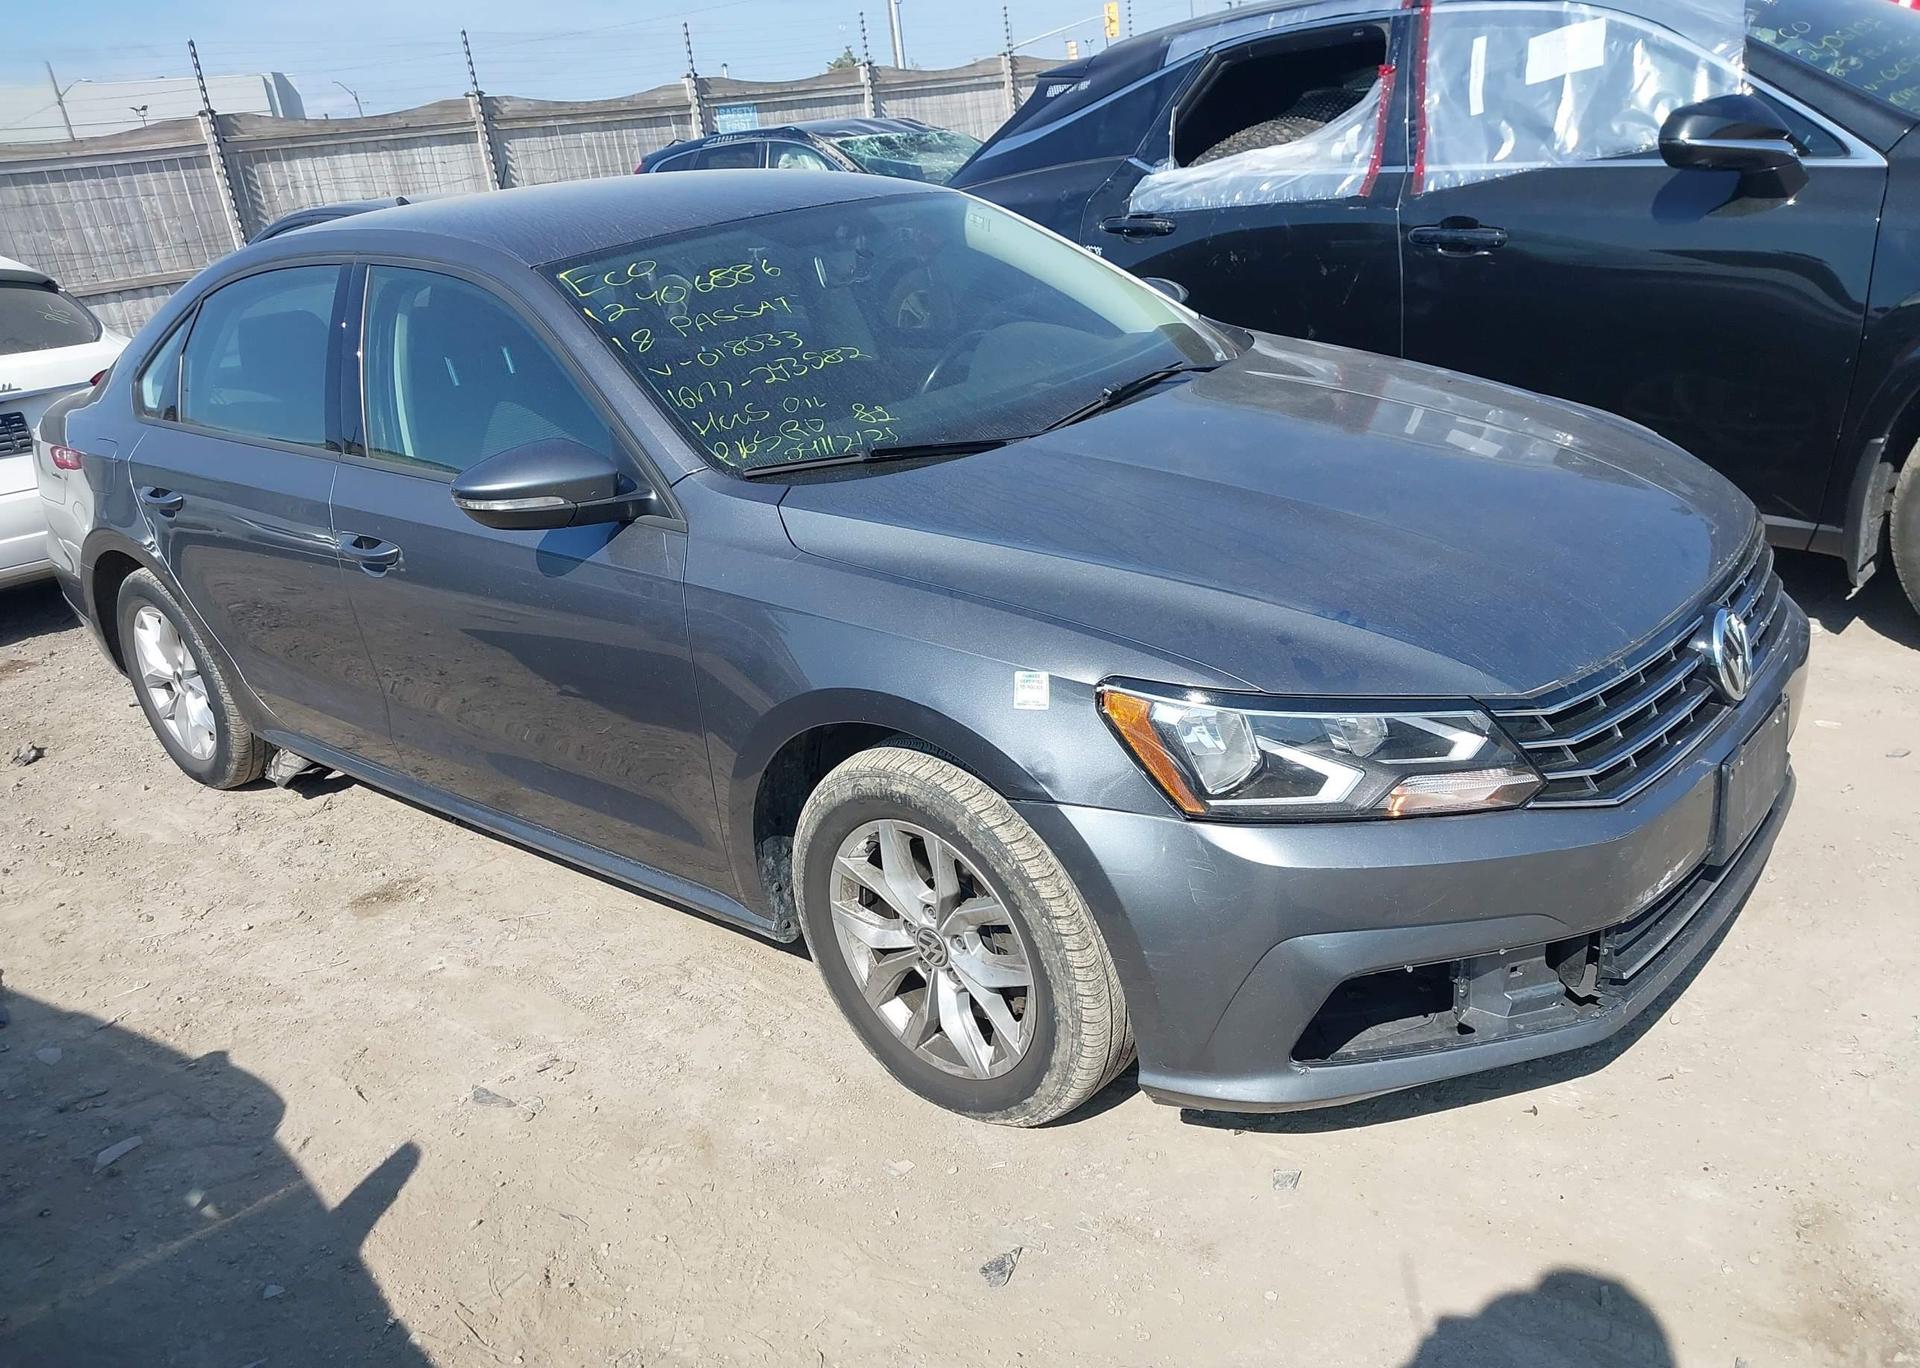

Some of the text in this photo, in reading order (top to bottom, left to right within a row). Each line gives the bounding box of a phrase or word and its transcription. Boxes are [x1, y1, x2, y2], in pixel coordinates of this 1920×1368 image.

[719, 106, 753, 117] SAFETY
[557, 261, 656, 297] ECO
[670, 296, 792, 337] PASSAT
[783, 397, 827, 413] OIL
